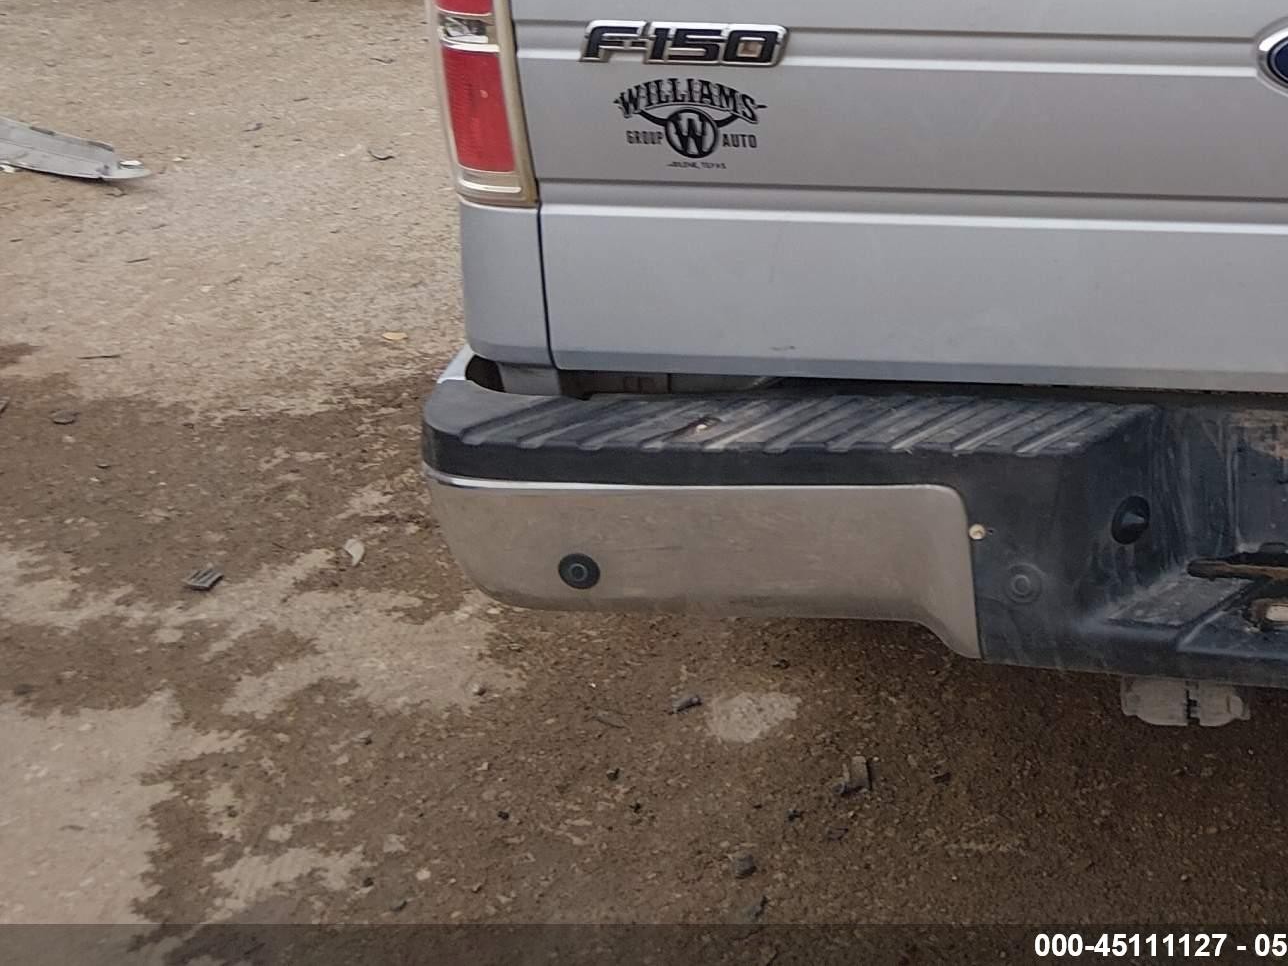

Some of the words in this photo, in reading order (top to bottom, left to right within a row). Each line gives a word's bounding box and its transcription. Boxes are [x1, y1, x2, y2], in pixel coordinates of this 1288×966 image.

[579, 20, 788, 67] F-150
[613, 78, 767, 124] WILLIAMS
[626, 130, 663, 145] GROUP
[722, 133, 758, 148] AUTO
